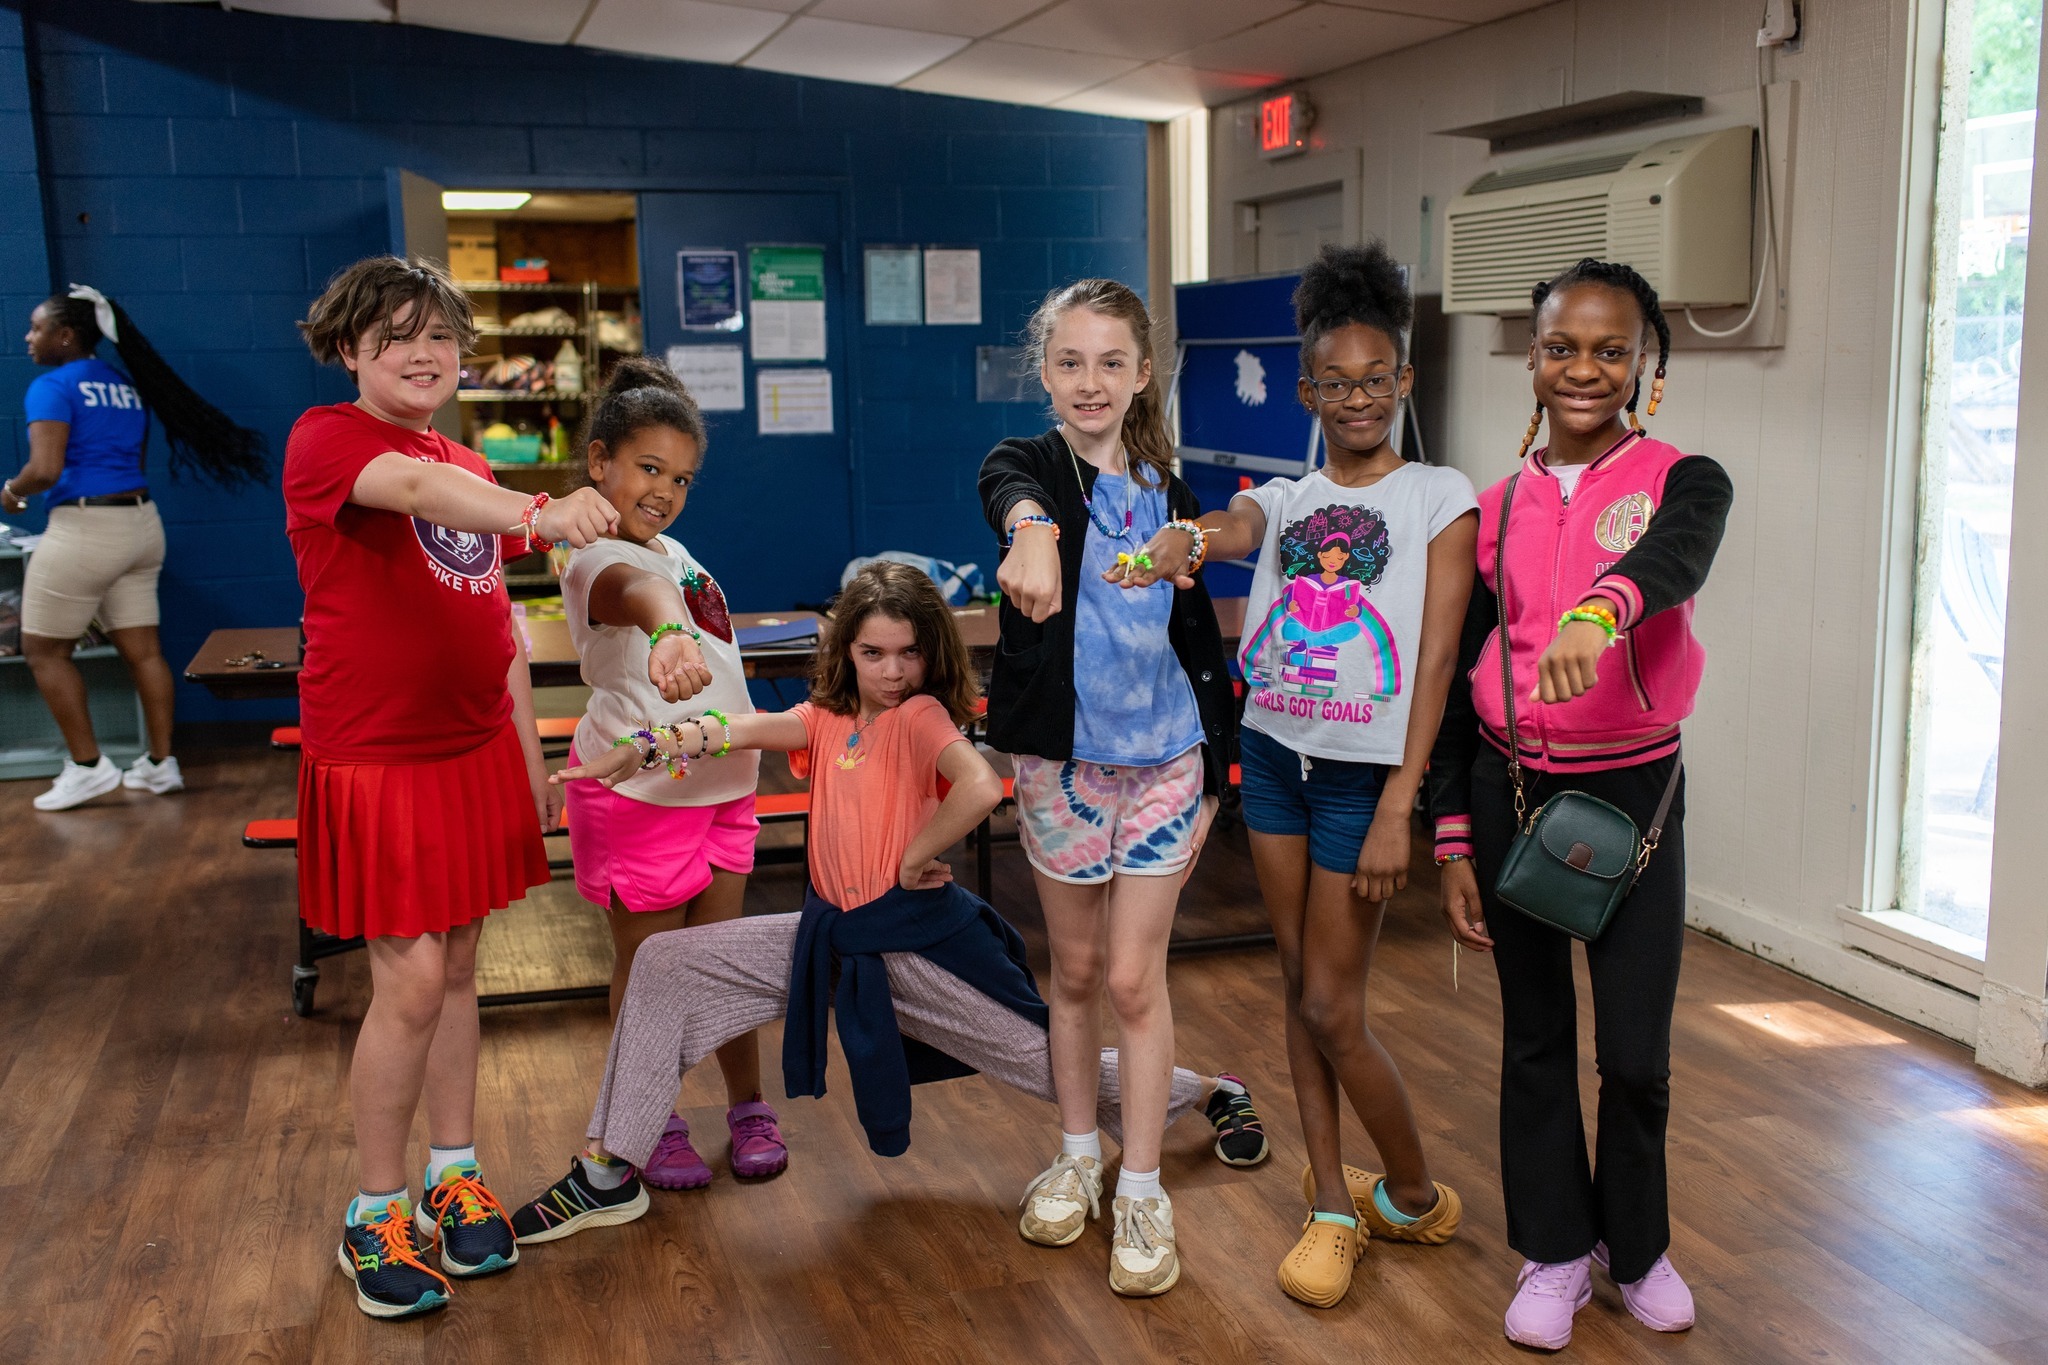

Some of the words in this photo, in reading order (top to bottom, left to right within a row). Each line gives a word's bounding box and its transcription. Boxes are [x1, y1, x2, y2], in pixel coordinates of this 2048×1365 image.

[1262, 95, 1292, 151] EXIT
[428, 560, 463, 592] PIKE
[1254, 688, 1285, 713] GIRLS
[1289, 696, 1316, 719] GOT
[1321, 699, 1373, 724] GOALS
